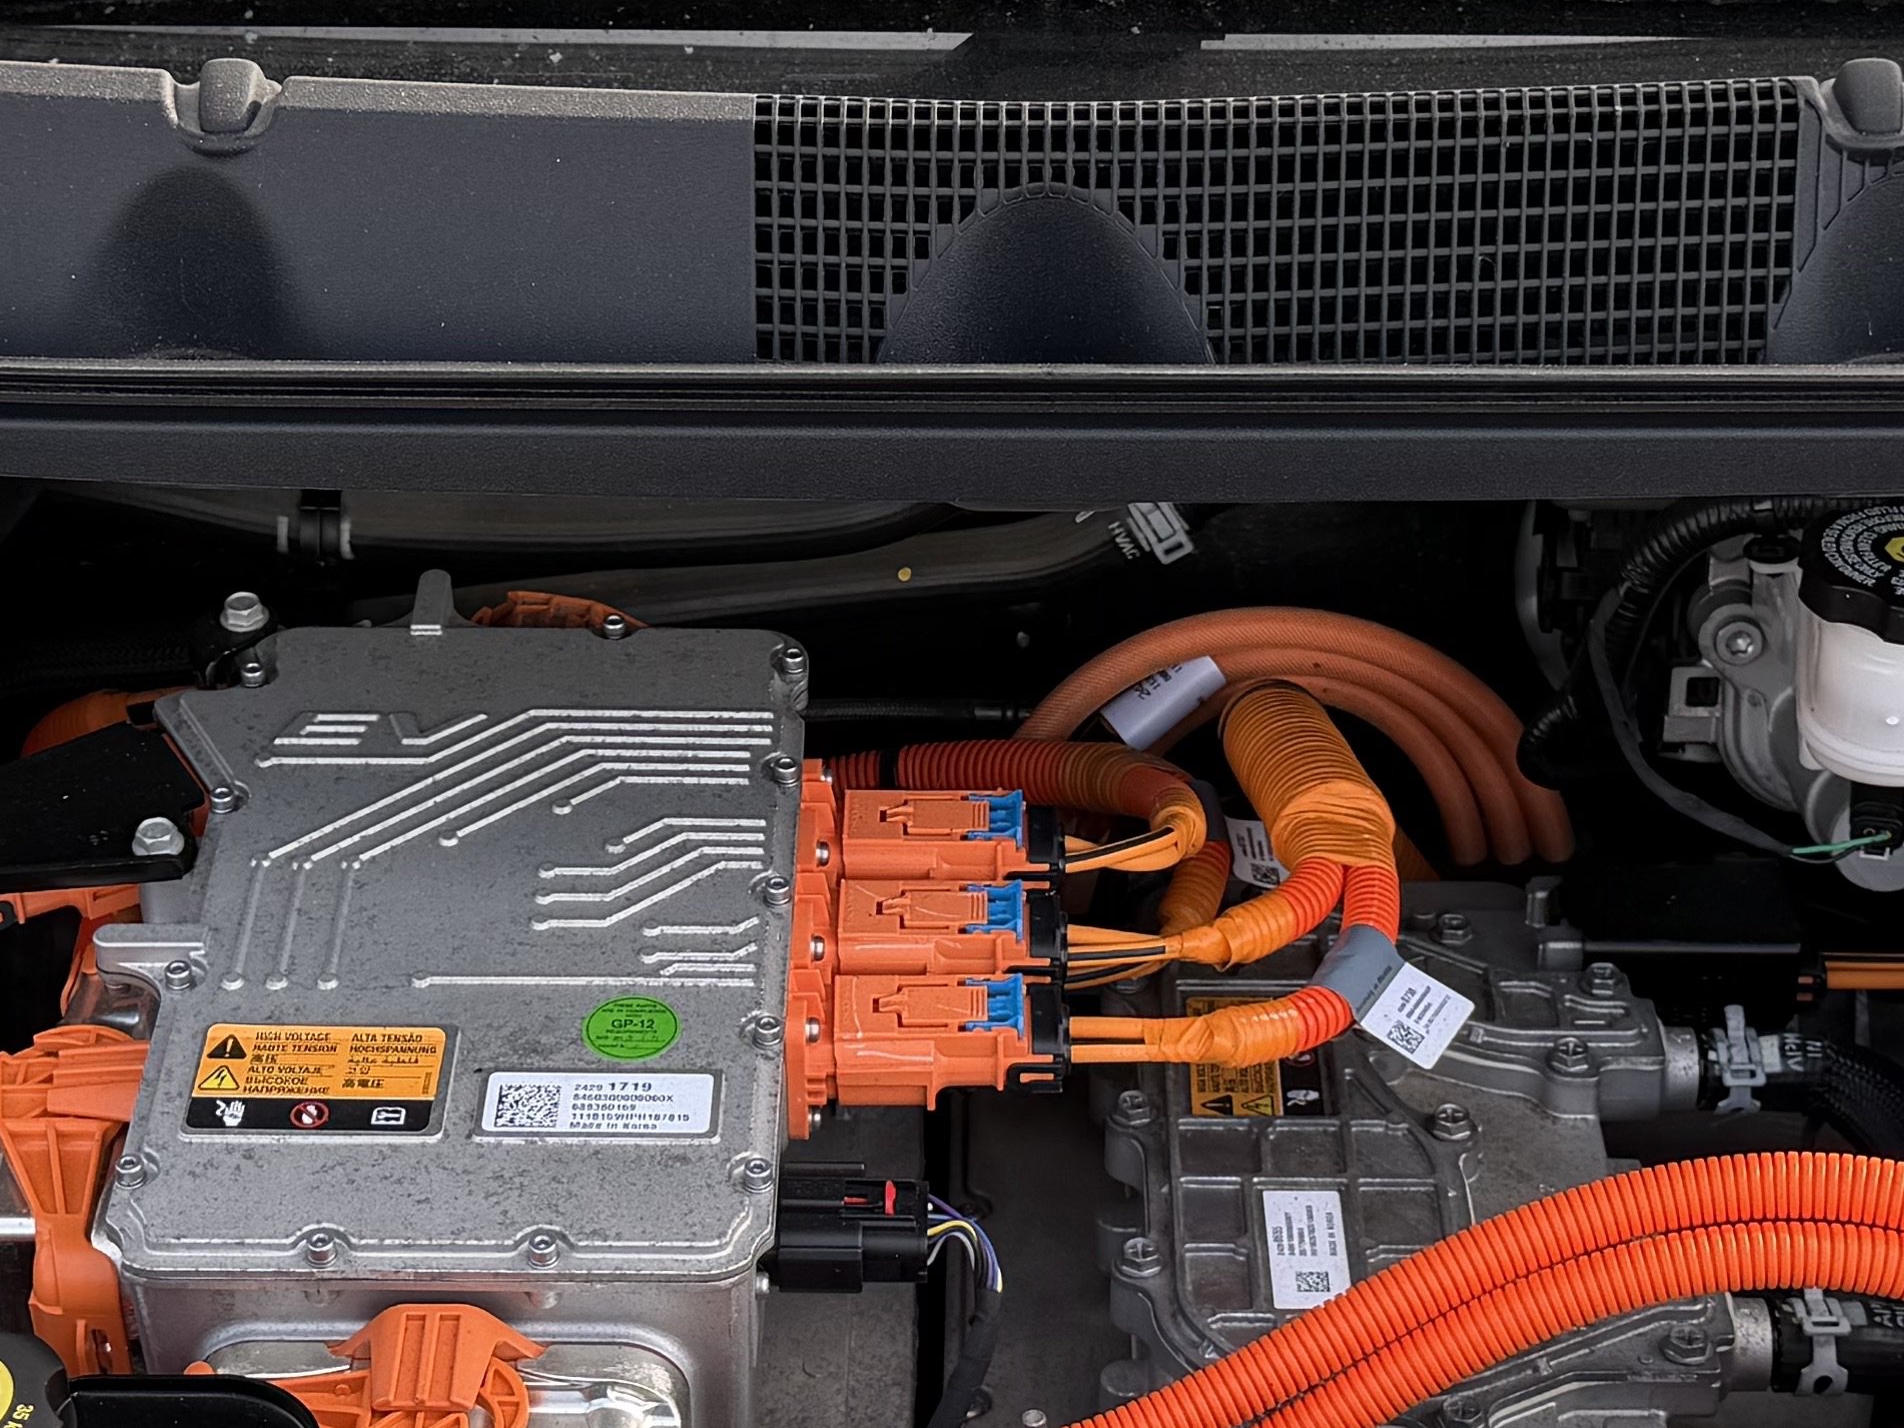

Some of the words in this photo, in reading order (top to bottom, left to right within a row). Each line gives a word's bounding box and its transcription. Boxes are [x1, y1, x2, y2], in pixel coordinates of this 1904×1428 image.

[611, 1018, 656, 1029] GP-12
[256, 1031, 282, 1041] HIGH
[284, 1032, 331, 1042] VOLTAGE
[351, 1033, 378, 1043] ALTA
[381, 1033, 423, 1043] TENSÃO
[252, 1044, 289, 1052] HAUTE
[292, 1044, 338, 1053] TENSION
[349, 1045, 437, 1054] HOCHSPANNUNG
[248, 1065, 275, 1074] ALTO
[277, 1065, 322, 1074] VOLTAJE
[608, 1082, 652, 1092] 1719
[622, 1122, 657, 1130] Korea
[16, 1403, 35, 1423] 35
